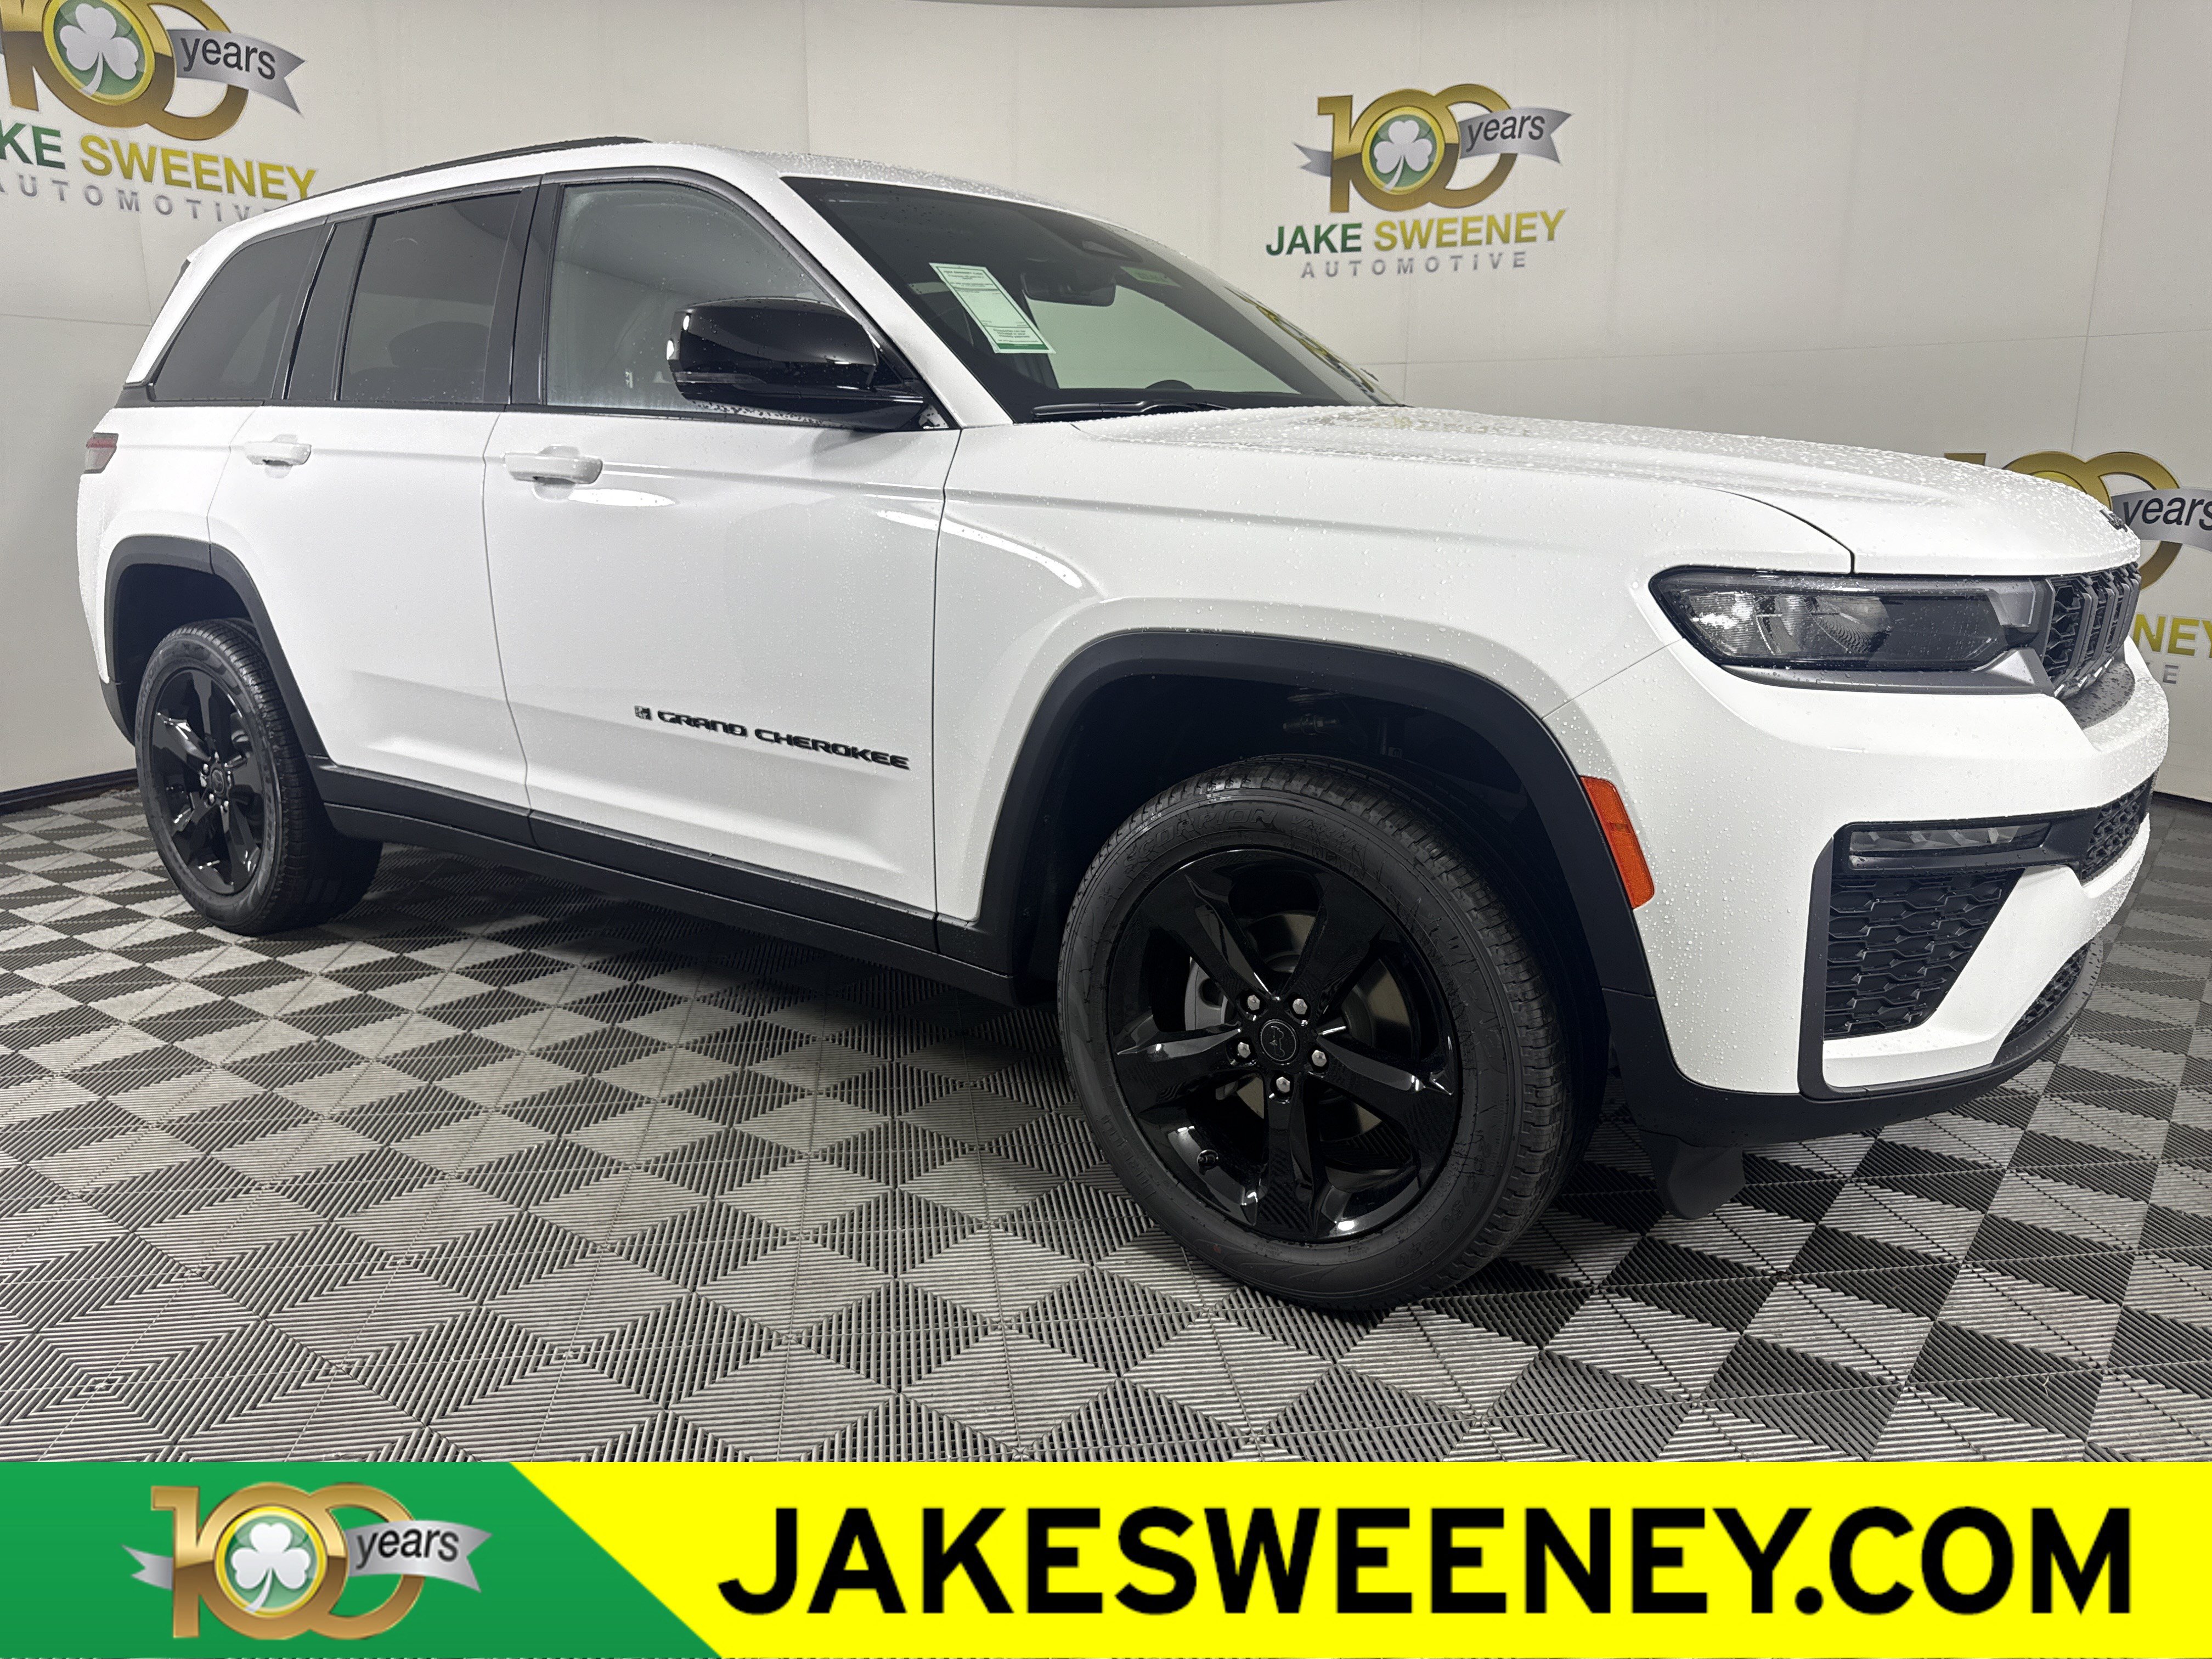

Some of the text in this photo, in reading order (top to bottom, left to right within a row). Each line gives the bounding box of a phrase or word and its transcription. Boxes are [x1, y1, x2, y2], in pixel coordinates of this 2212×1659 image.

[180, 37, 275, 80] years
[1465, 113, 1545, 153] years
[0, 120, 317, 201] KE SWEENEY
[0, 174, 274, 222] UTOMOTIV
[1266, 208, 1567, 256] JAKE SWEENEY
[1301, 251, 1526, 278] AUTOMOTIVE
[658, 710, 911, 770] GRAND CHEROKEE
[1123, 808, 1278, 878] SCORPION
